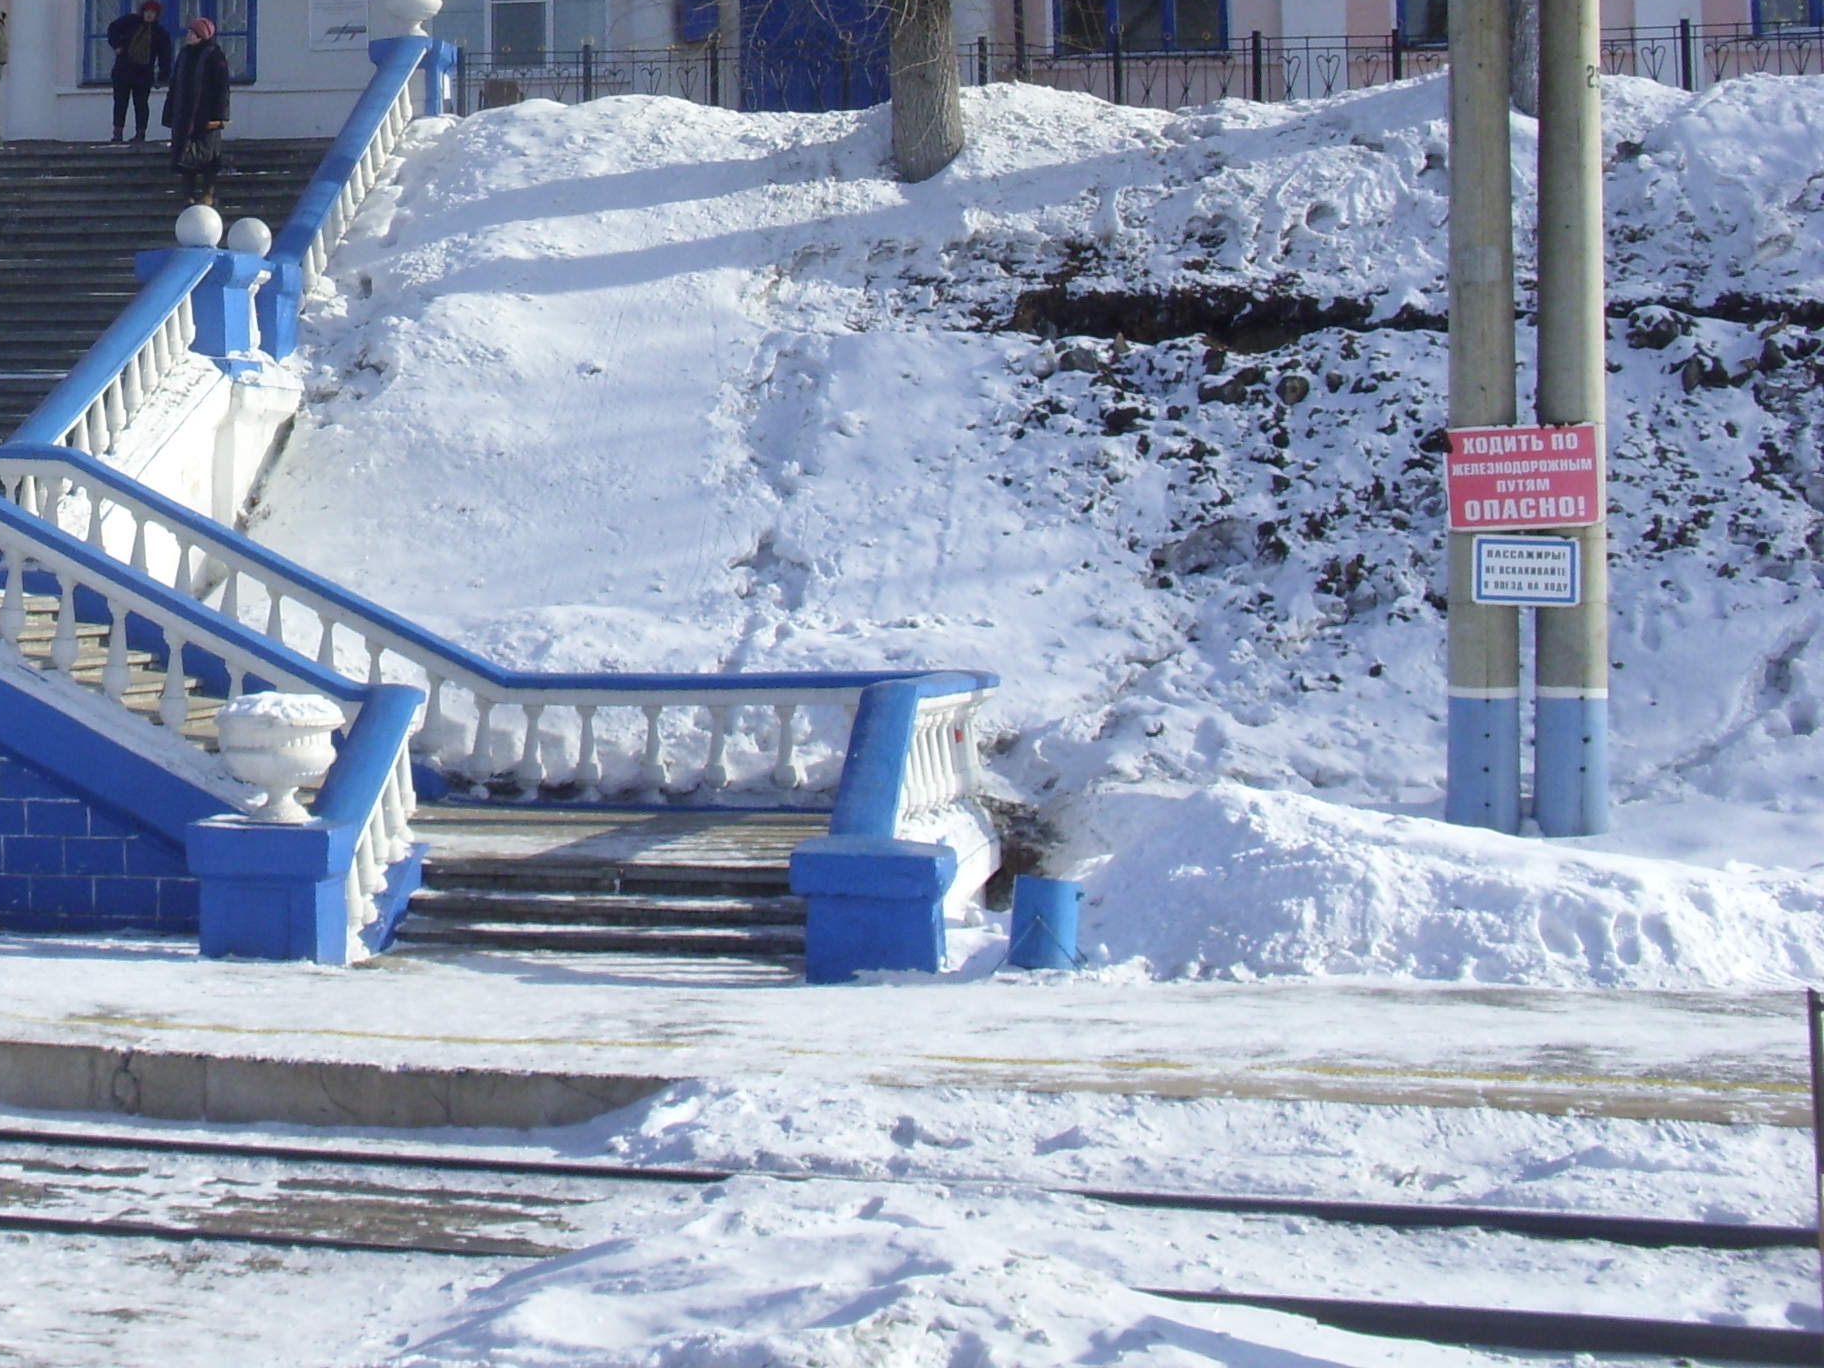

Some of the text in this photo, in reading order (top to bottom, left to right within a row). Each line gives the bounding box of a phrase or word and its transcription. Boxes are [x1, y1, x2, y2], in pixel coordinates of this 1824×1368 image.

[1462, 433, 1578, 455] ХОДИТЬ ПО
[1452, 458, 1592, 476] ЖЕЛЕЗНОДОРОЖНЫМ
[1496, 478, 1551, 492] ПУТЯМ
[1464, 495, 1586, 521] ОПАСНО!
[1485, 565, 1566, 576] НЕ ВСКАКИВАЙТЕ
[1494, 580, 1523, 591] ПОЕЗД
[1527, 581, 1539, 590] НА
[1544, 582, 1568, 593] ХОДУ
